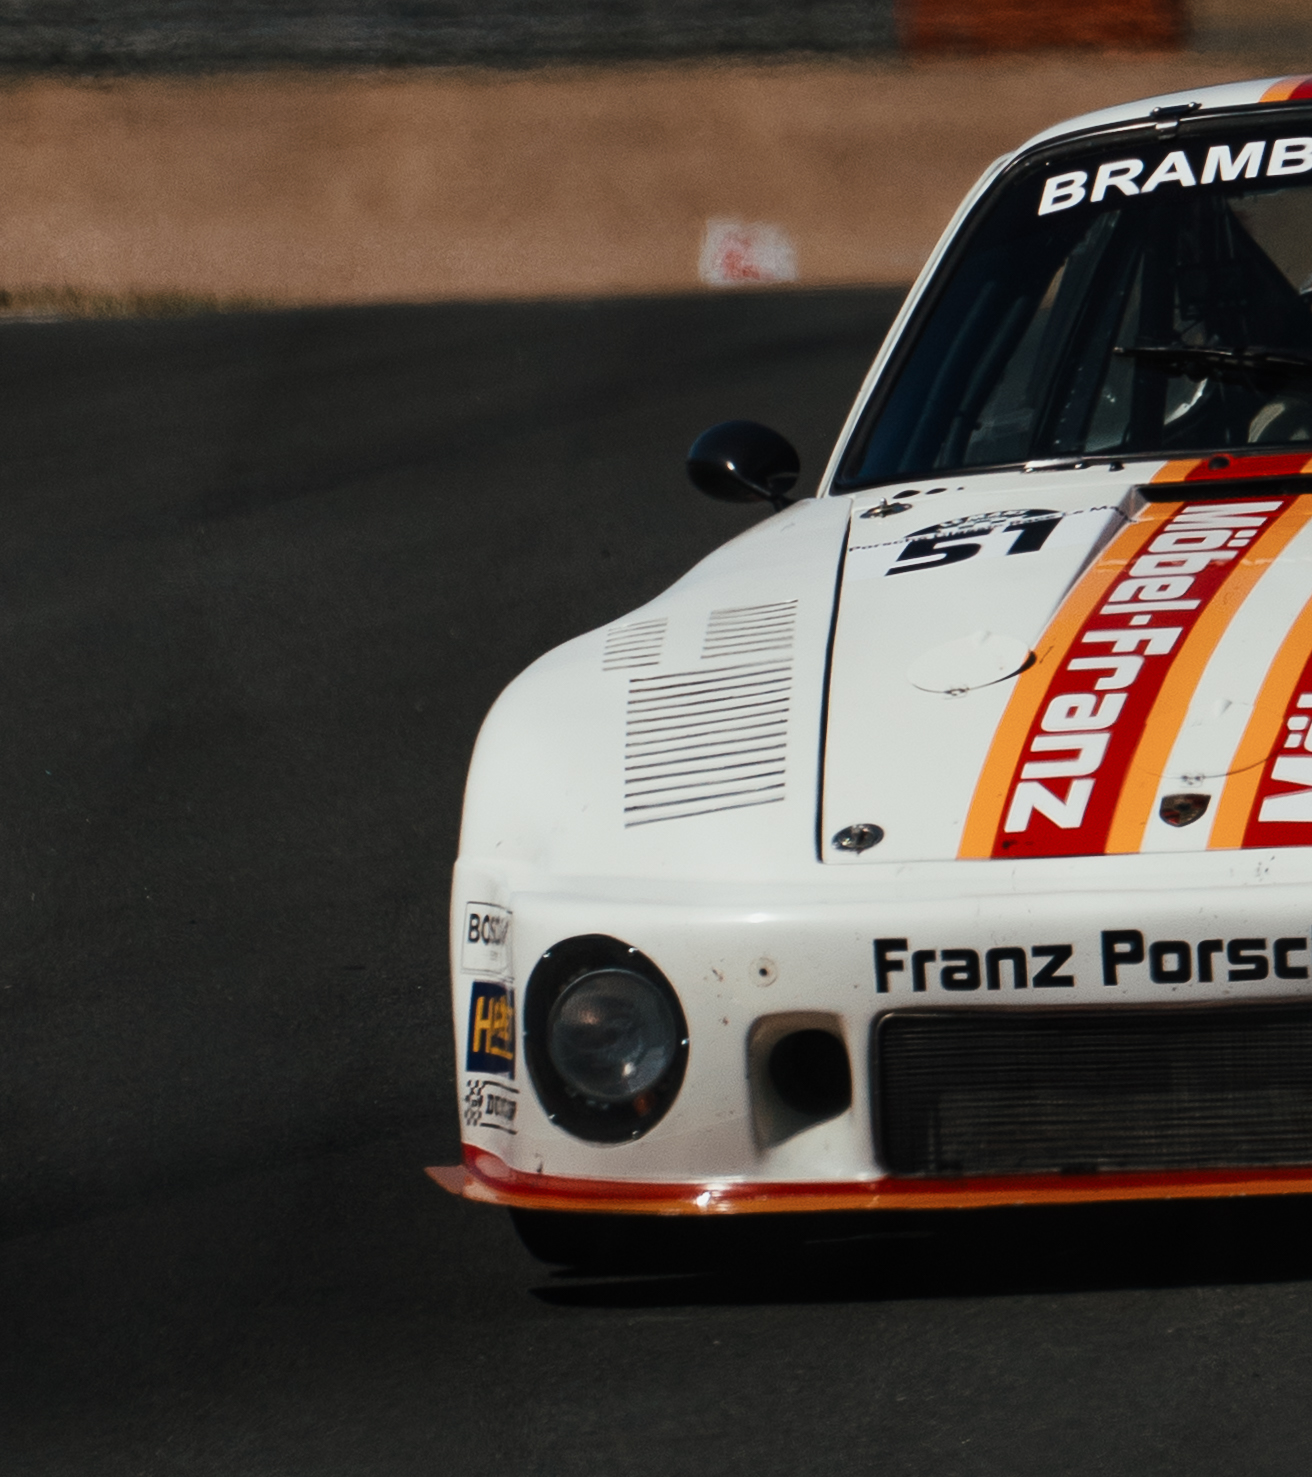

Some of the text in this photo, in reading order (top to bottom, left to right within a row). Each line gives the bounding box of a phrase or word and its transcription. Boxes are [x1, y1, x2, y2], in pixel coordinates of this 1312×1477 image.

[884, 516, 1063, 576] 51
[1004, 500, 1284, 834] Möbel-Franz
[873, 937, 1074, 993] Franz
